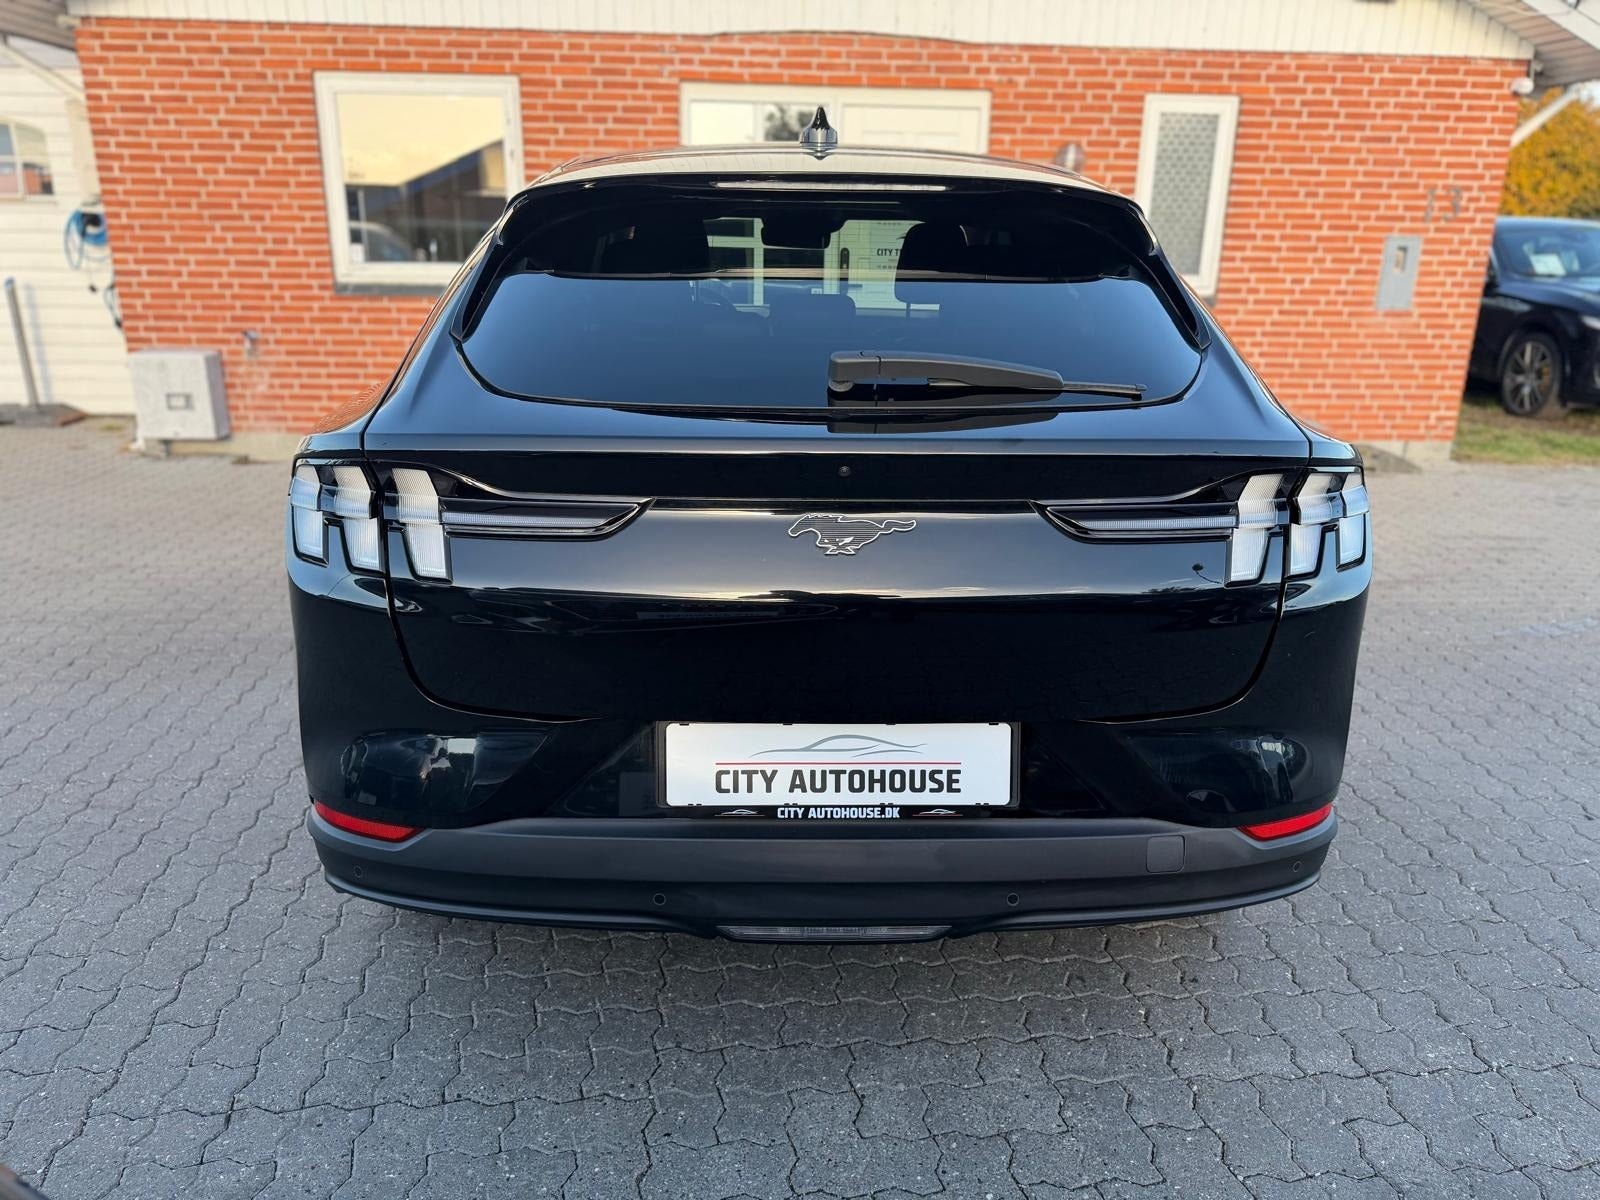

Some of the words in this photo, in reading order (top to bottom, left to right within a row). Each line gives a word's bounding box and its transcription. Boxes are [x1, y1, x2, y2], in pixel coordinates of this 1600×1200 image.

[876, 248, 893, 256] CITY
[715, 769, 778, 793] CITY
[788, 769, 962, 793] AUTOHOUSE
[777, 807, 804, 819] CITY
[808, 807, 900, 819] AUTOHOUSE.DK
